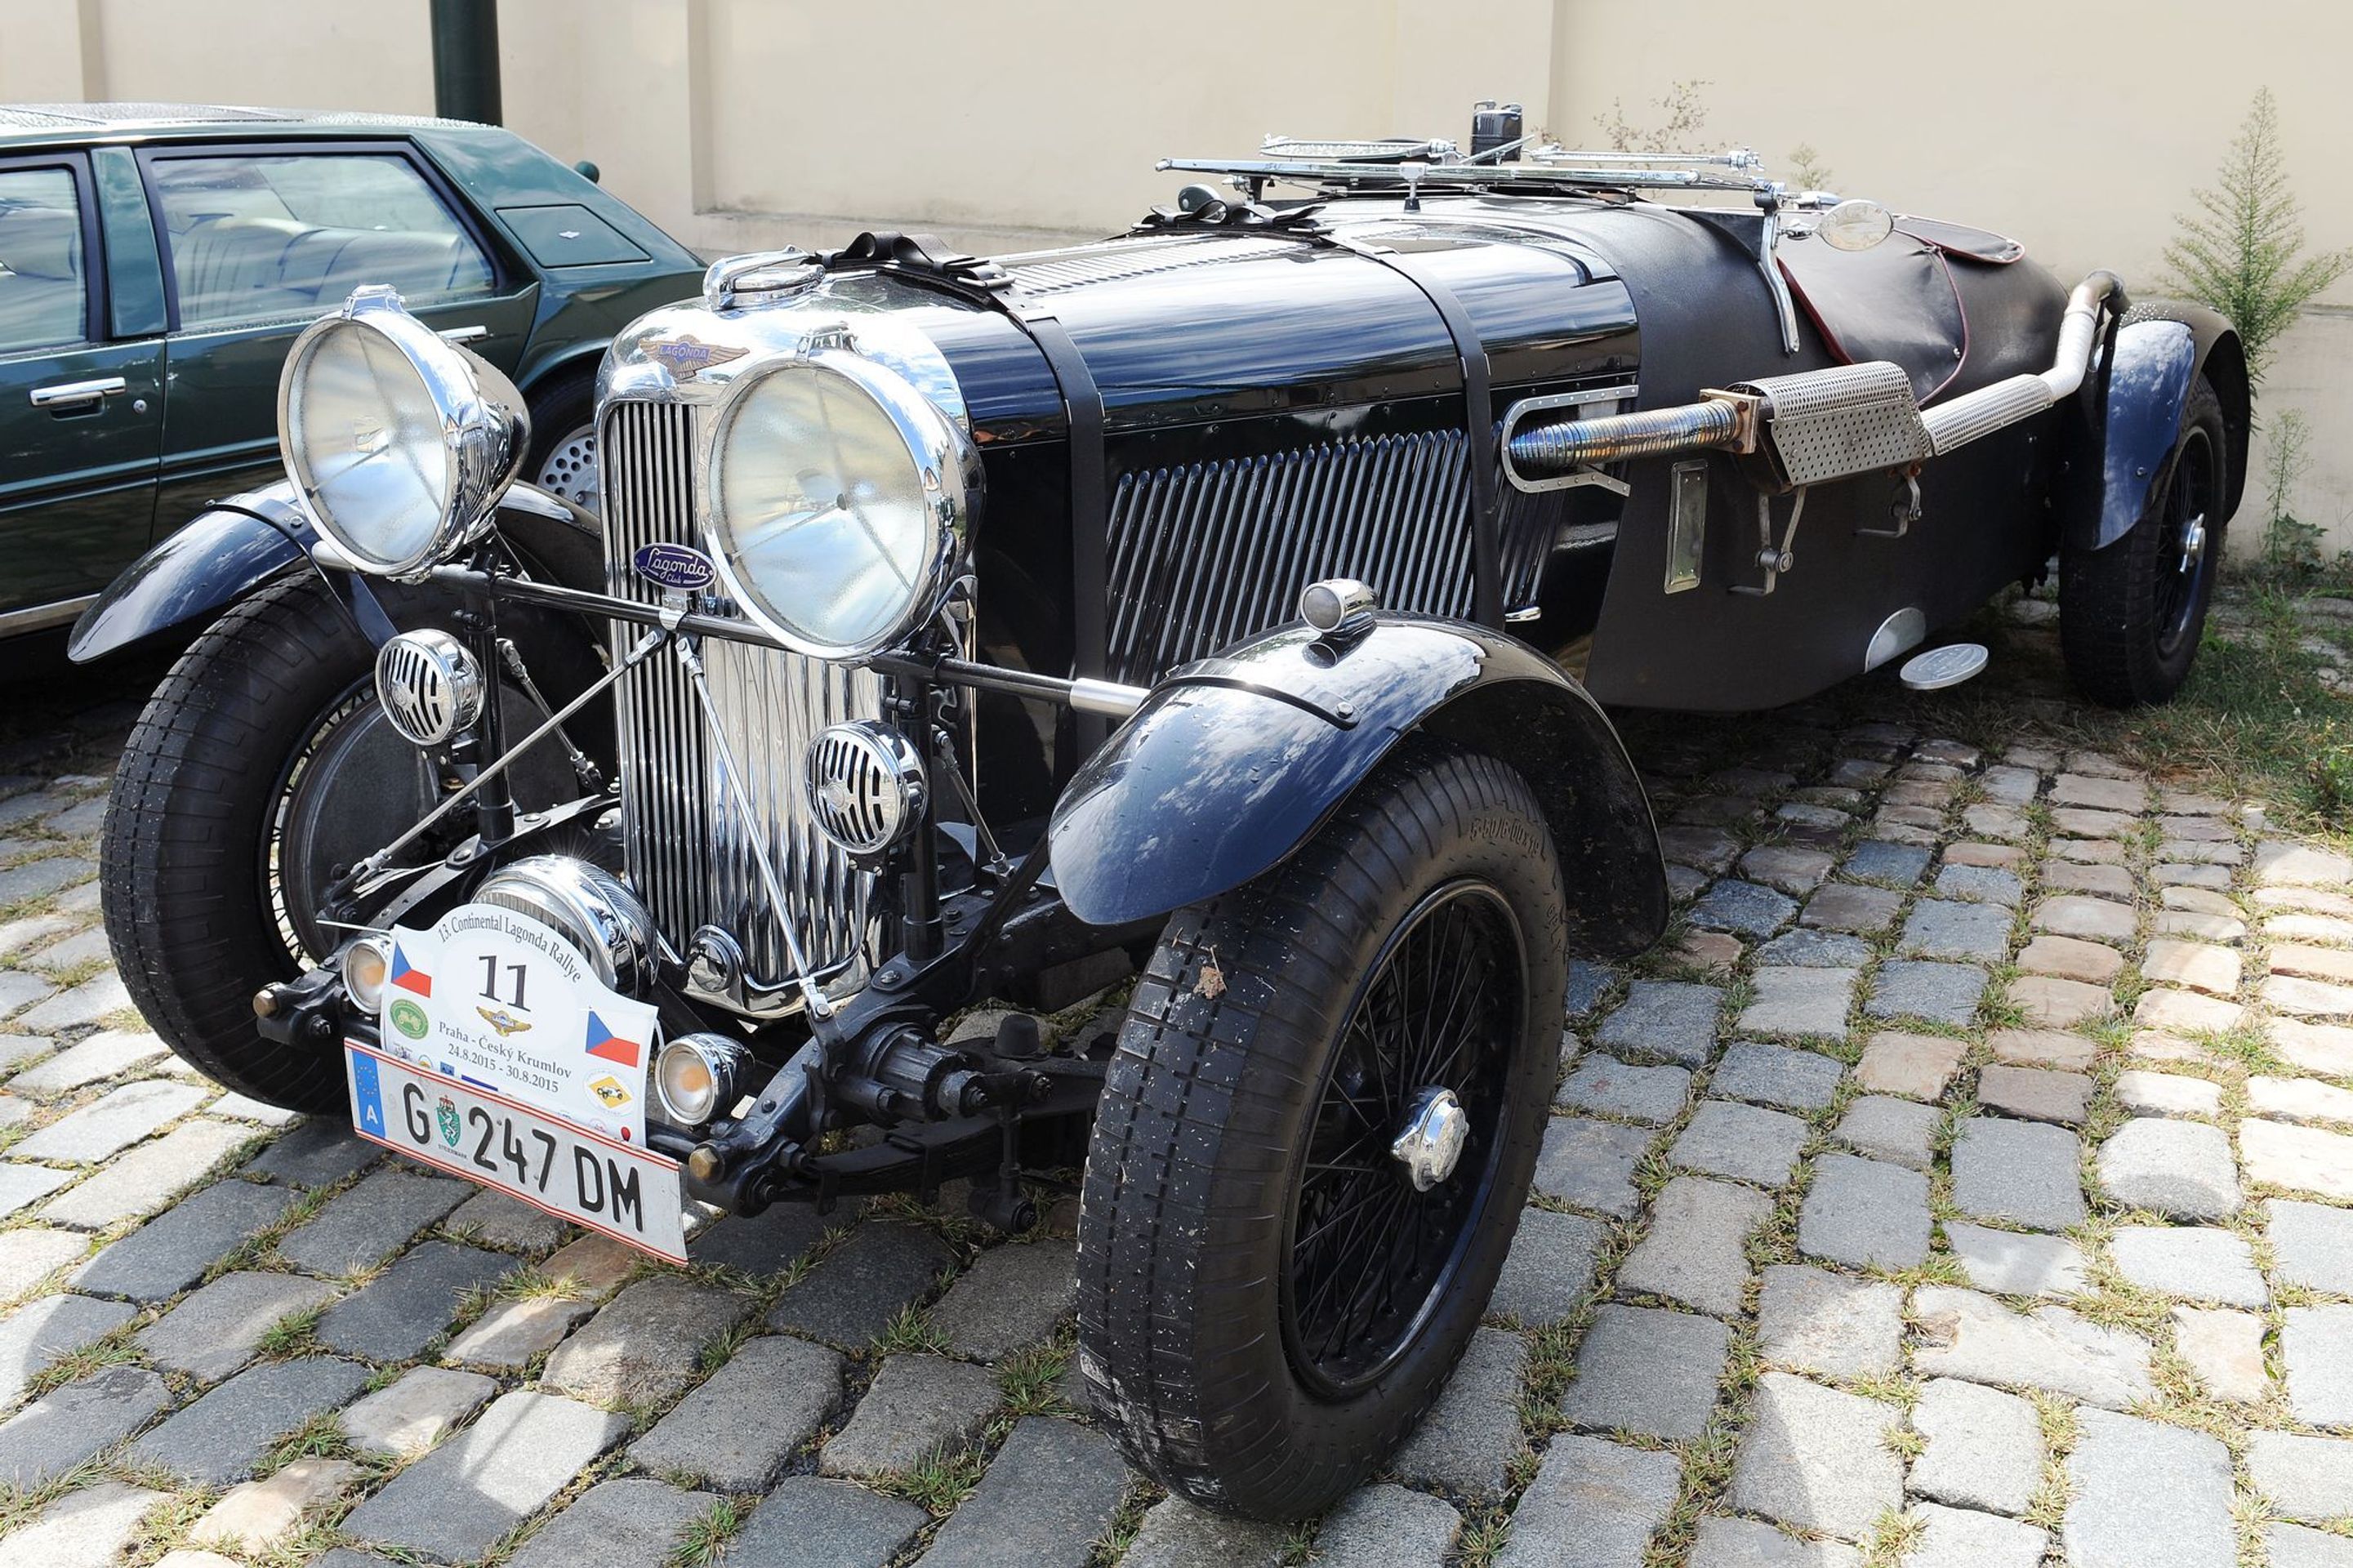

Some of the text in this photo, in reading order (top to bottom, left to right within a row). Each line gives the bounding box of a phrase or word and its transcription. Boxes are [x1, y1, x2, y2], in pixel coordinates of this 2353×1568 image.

[660, 346, 707, 360] LAGONDA
[640, 548, 710, 583] Lagonda
[439, 912, 582, 982] 13. Continental Lagonda Rallye
[479, 955, 531, 1012] 11
[439, 1022, 468, 1043] Praha
[479, 1035, 514, 1061] Český
[518, 1050, 572, 1079] Krumlov
[448, 1044, 496, 1071] 24.8.2015
[506, 1066, 559, 1093] 30.8.2015
[367, 1105, 379, 1125] A
[403, 1083, 644, 1232] G 247 DM
